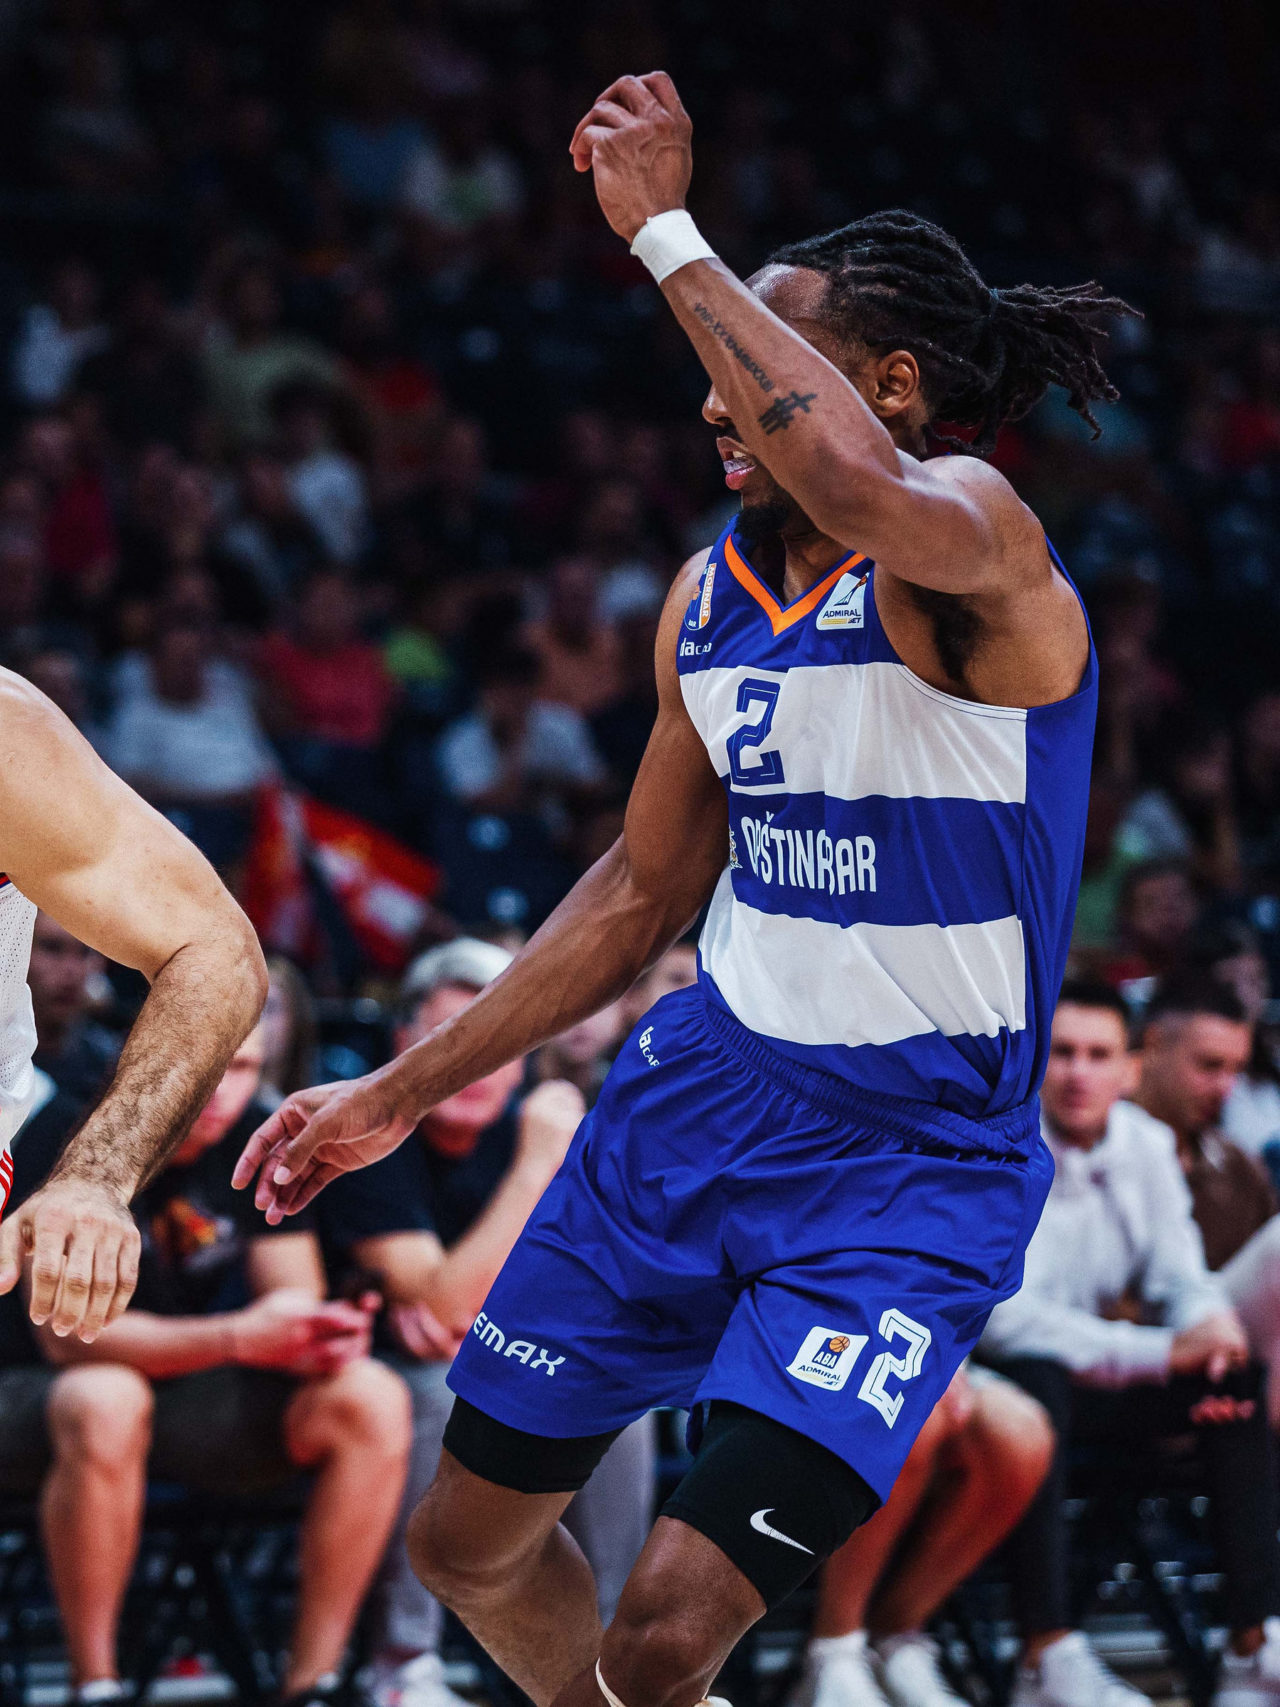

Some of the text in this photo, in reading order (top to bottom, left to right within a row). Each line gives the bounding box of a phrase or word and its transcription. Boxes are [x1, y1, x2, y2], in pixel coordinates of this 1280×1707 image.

[702, 566, 716, 617] MORNAR
[823, 609, 862, 618] ADMIRAL
[726, 677, 786, 787] 2
[797, 1364, 842, 1381] ADMIRAL
[814, 1351, 838, 1368] ABA
[857, 1307, 932, 1430] 2
